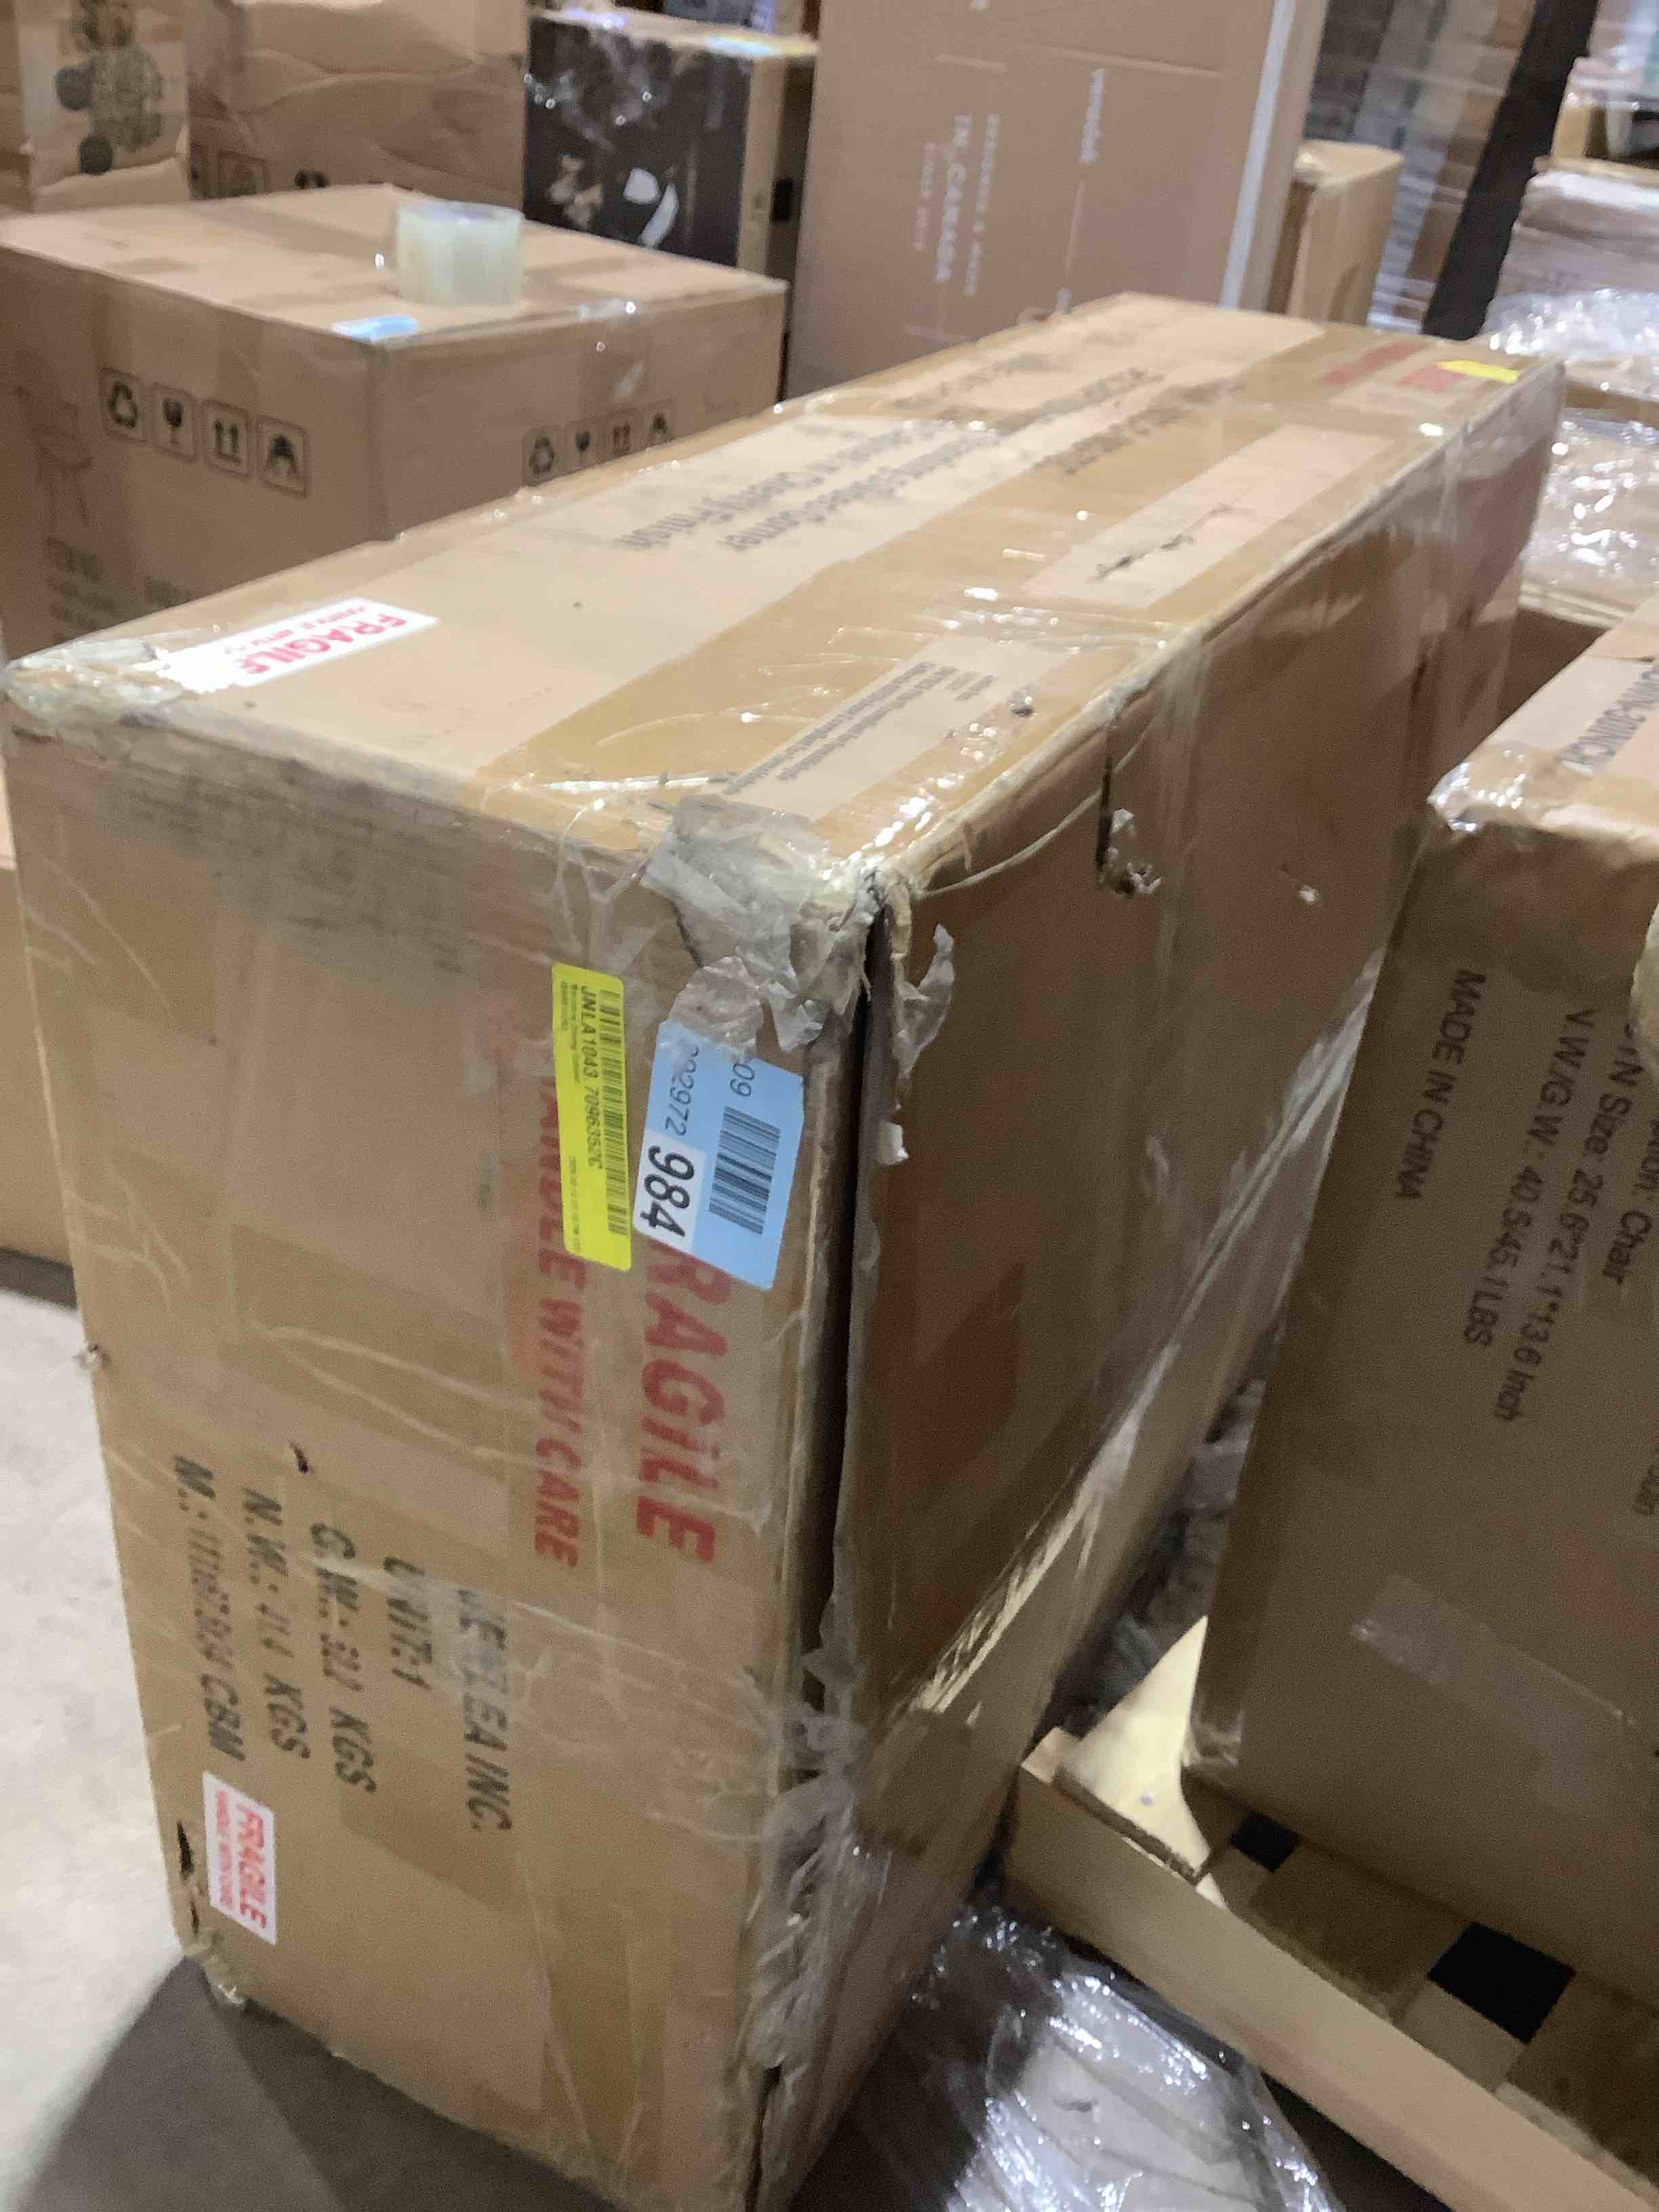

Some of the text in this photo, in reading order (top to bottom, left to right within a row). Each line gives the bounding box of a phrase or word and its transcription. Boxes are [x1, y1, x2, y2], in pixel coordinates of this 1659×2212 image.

[1396, 969, 1486, 1199] MADE IN CHINA
[640, 1144, 695, 1240] 984
[636, 1242, 733, 1563] RAGILE
[535, 1437, 581, 1568] CARE
[264, 1670, 311, 1760] KGS
[329, 1705, 377, 1795] KGS
[464, 1751, 513, 1832] INC.
